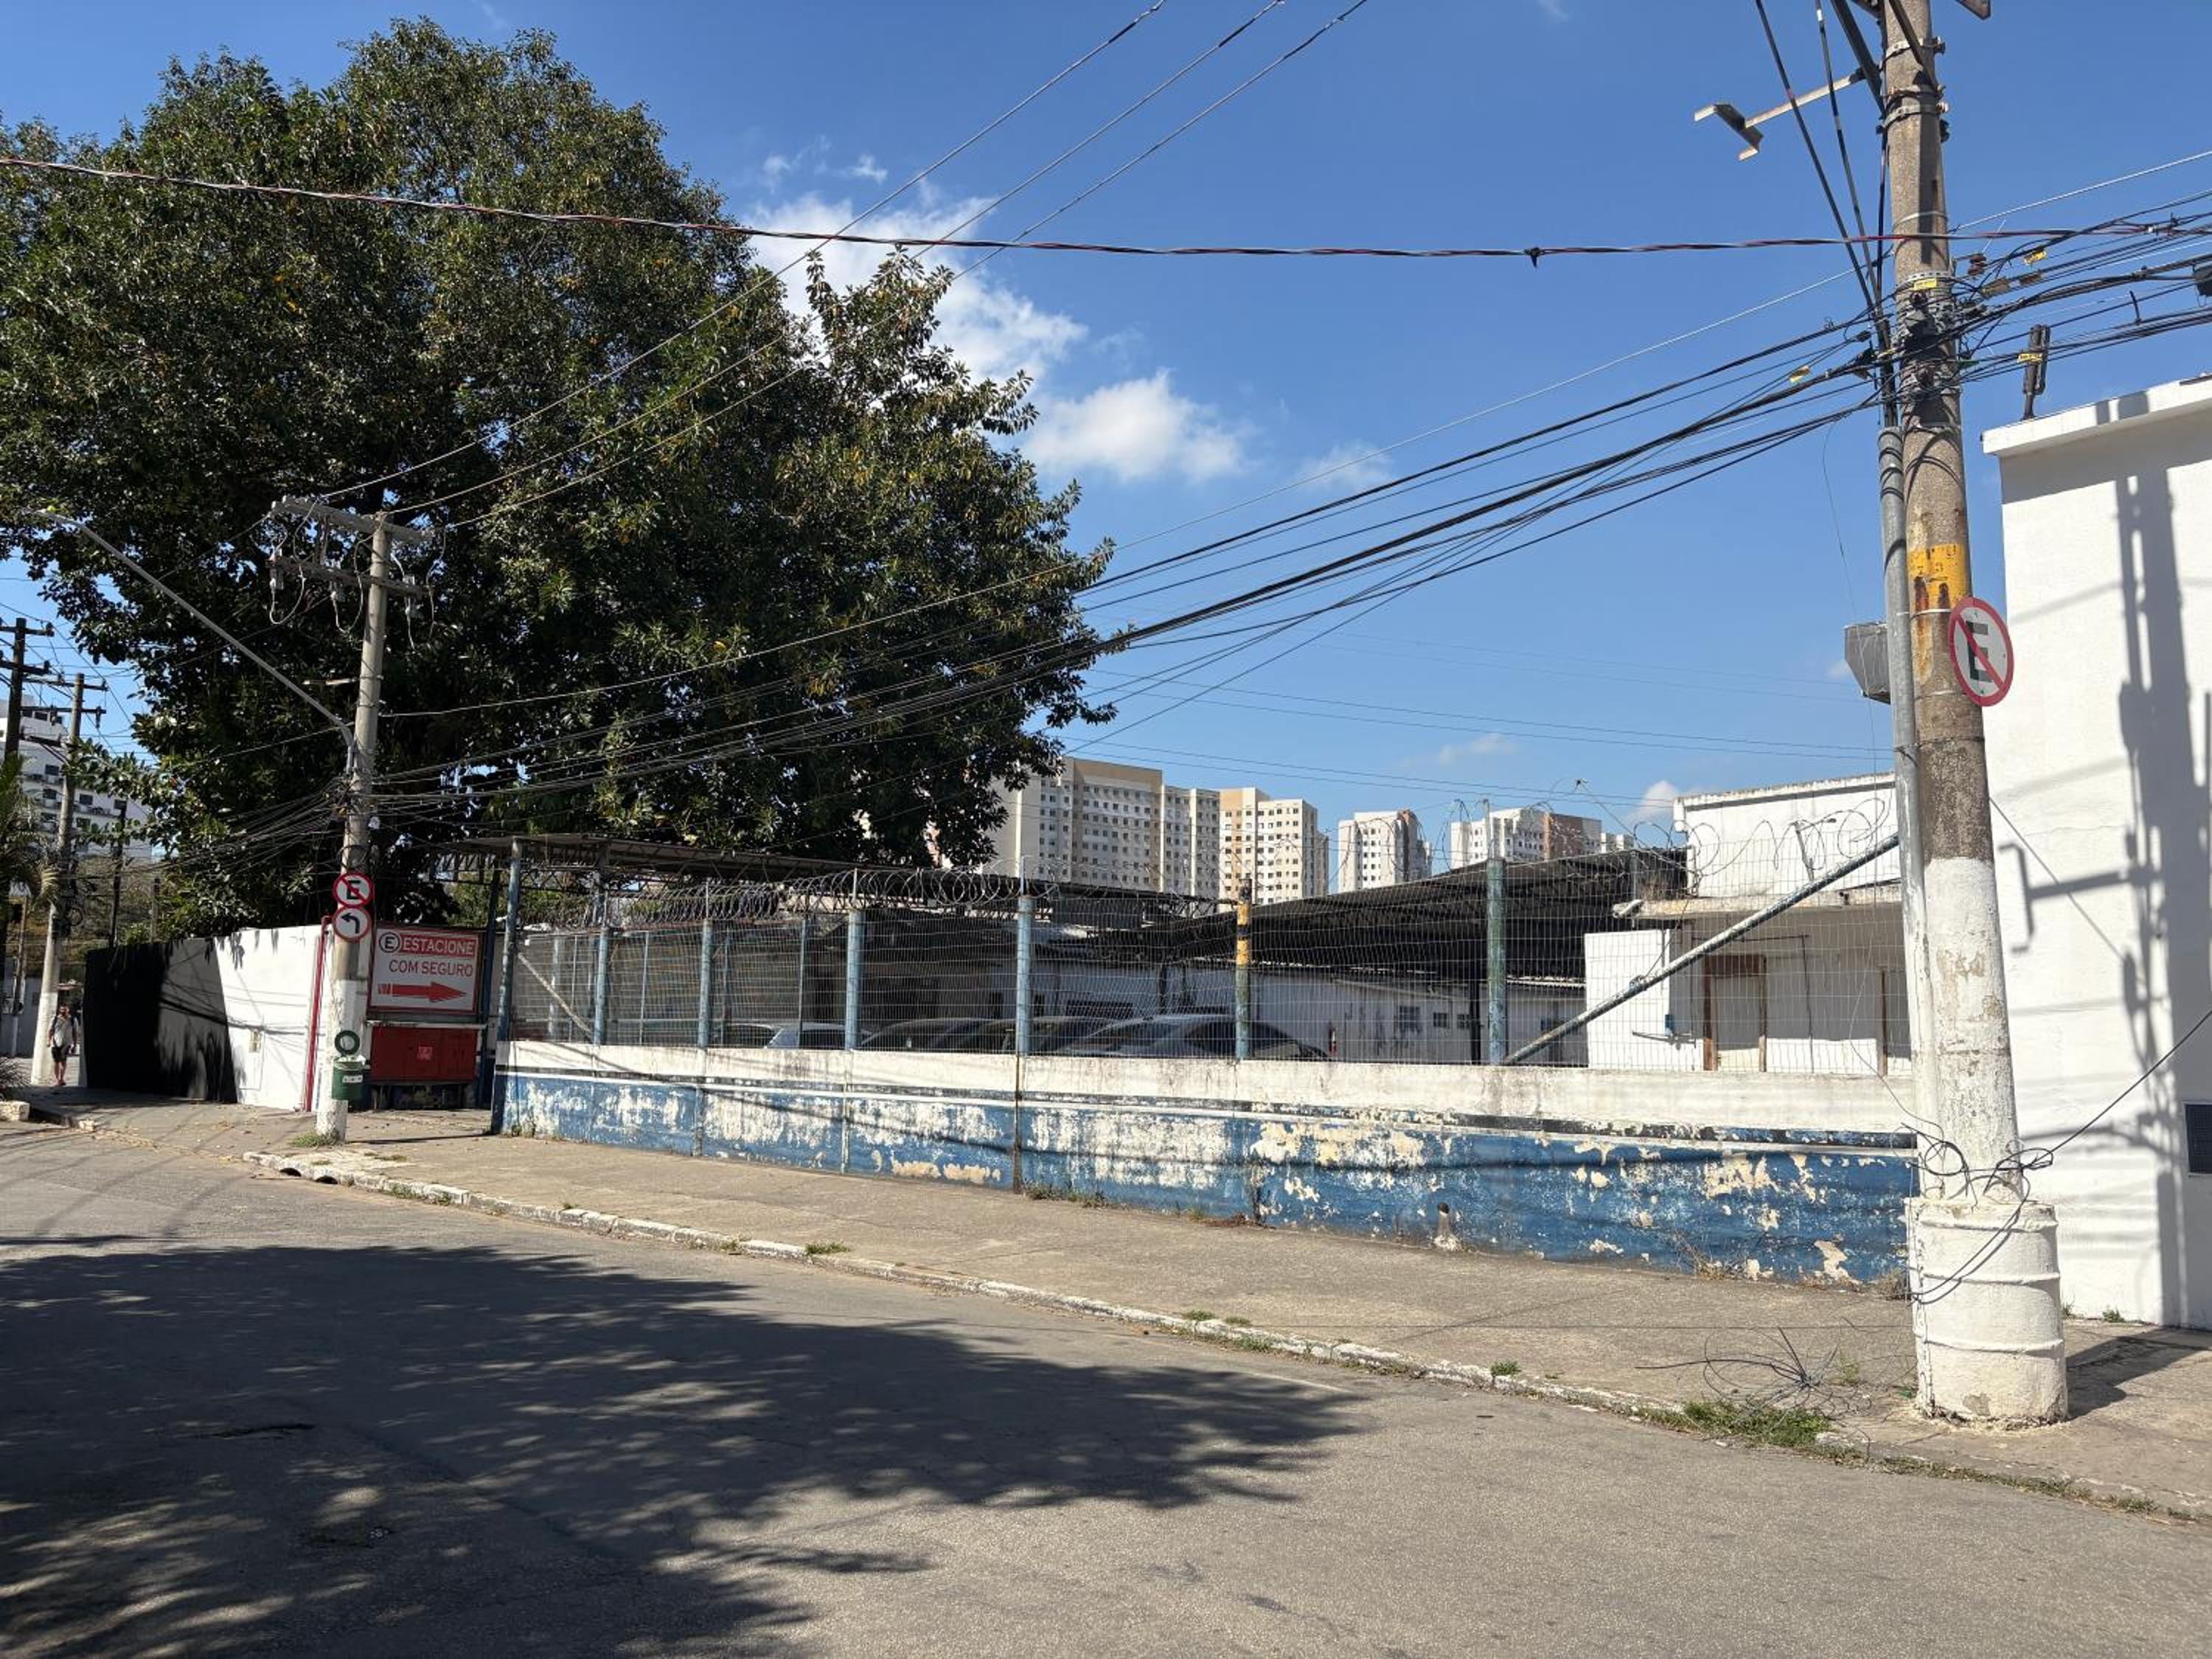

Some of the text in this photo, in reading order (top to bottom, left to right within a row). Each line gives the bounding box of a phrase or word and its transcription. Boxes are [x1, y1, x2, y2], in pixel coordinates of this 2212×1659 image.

[1966, 620, 1992, 683] E
[347, 880, 361, 900] E
[384, 936, 475, 955] E ESTACIONE
[389, 959, 473, 977] COM SEGURO
